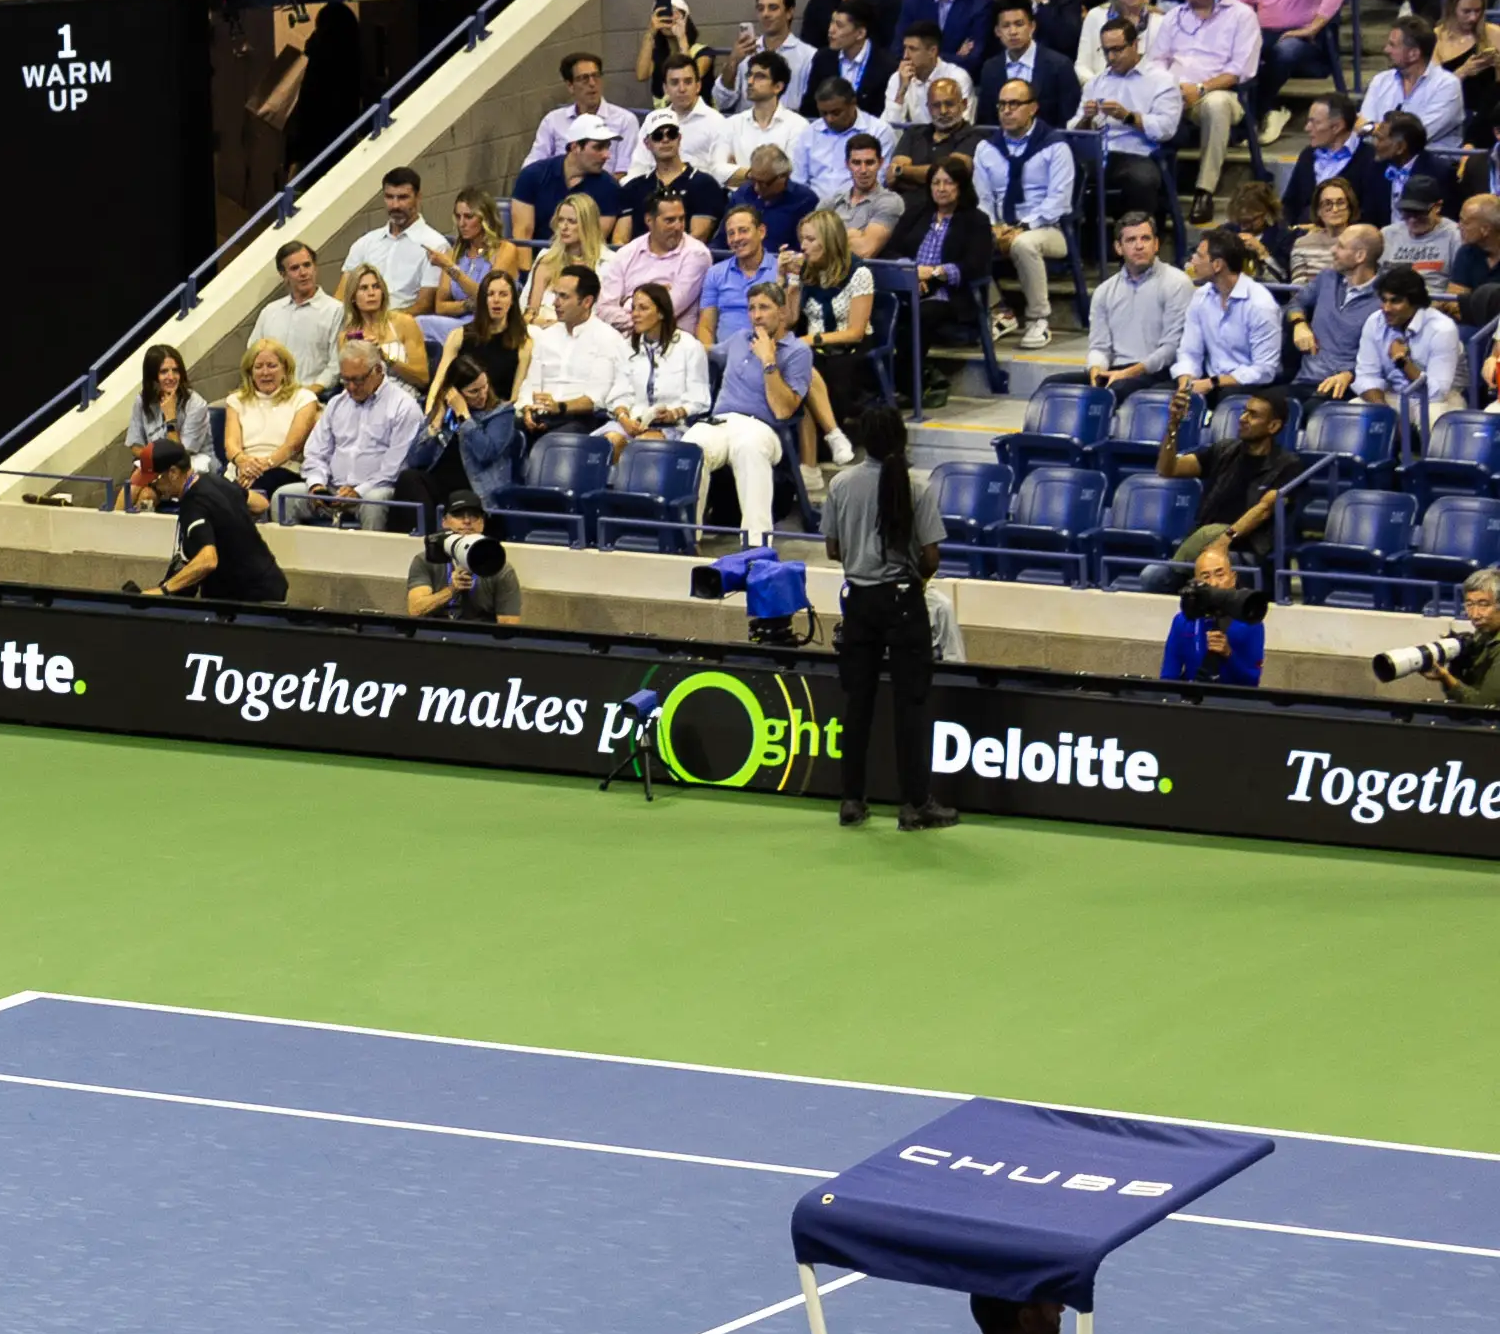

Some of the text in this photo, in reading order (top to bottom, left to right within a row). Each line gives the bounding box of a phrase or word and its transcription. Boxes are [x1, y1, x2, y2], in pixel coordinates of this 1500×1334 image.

[57, 23, 77, 56] 1
[22, 61, 112, 87] WARM
[49, 89, 88, 111] UP
[185, 653, 408, 722] Together
[418, 678, 585, 735] makes
[898, 1145, 1174, 1197] CHUBB
